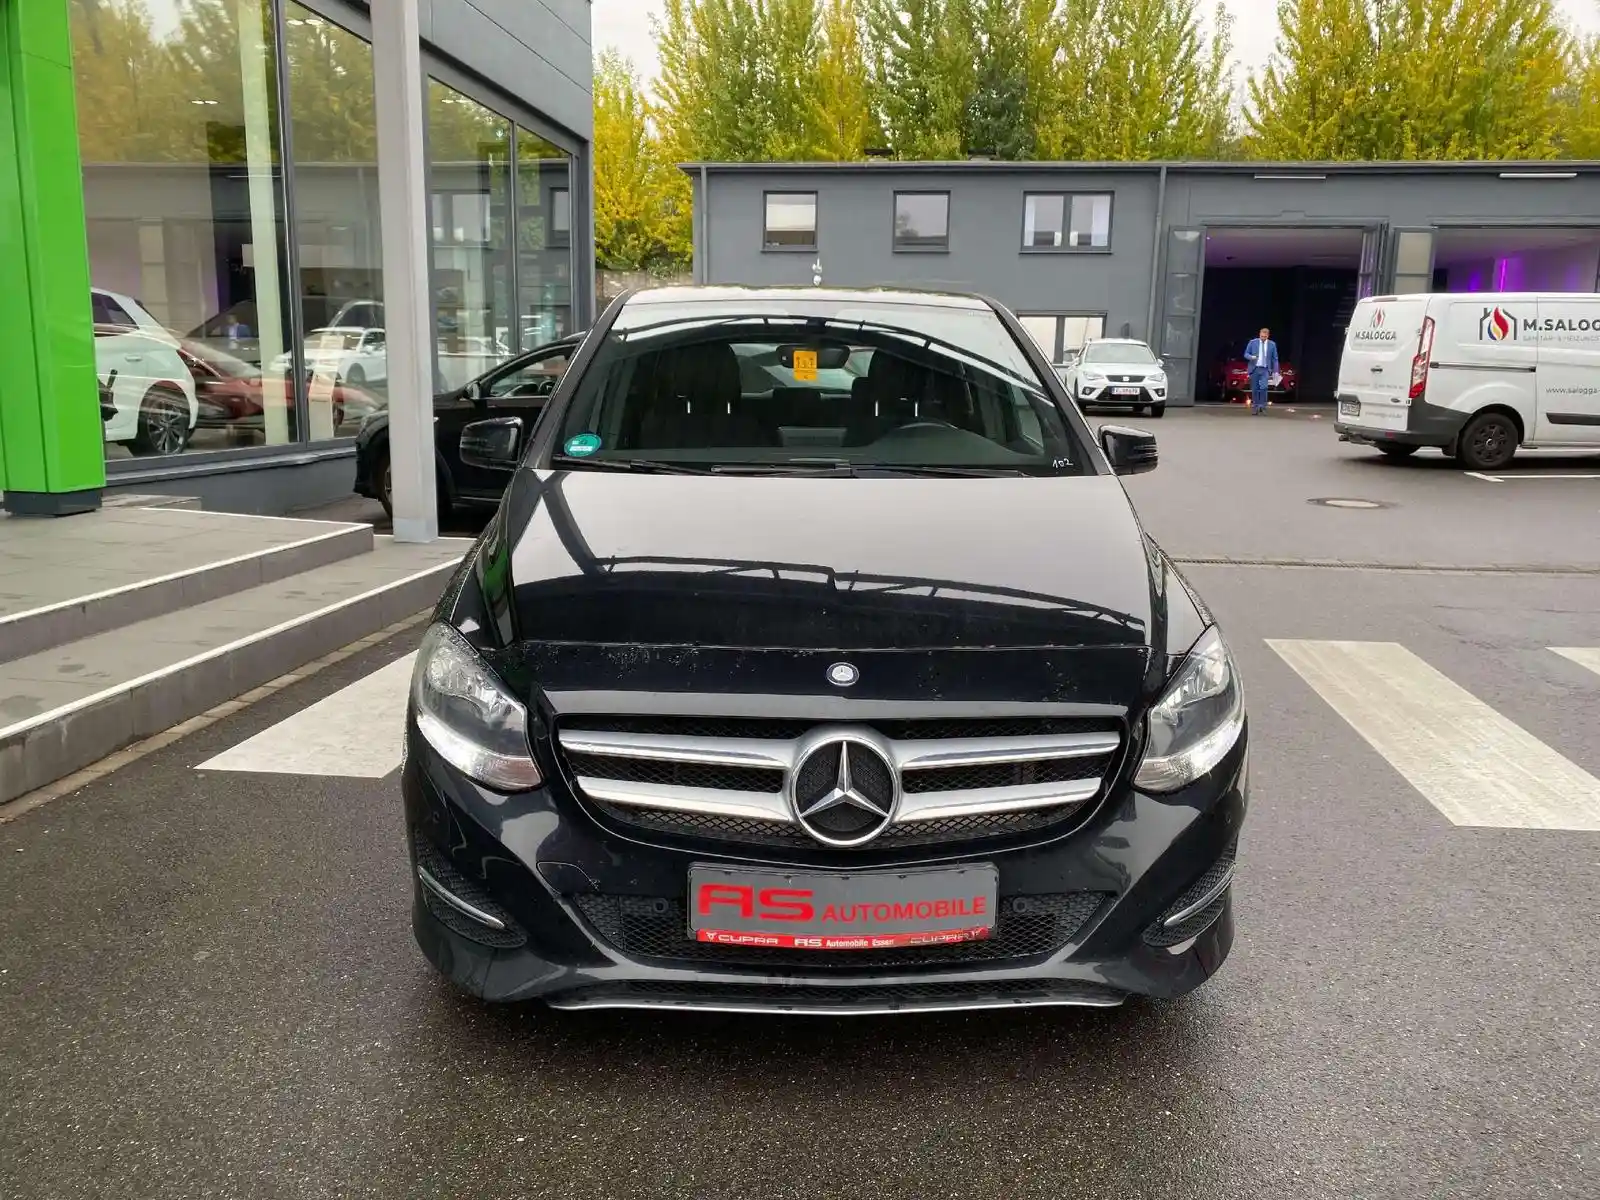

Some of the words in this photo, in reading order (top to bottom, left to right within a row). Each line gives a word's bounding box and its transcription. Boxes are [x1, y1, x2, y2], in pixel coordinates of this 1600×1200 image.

[1052, 458, 1073, 468] 102
[698, 883, 815, 922] AS
[821, 897, 986, 924] AUTOMOBILE
[718, 933, 779, 945] CUPRA
[794, 938, 823, 947] AS
[826, 939, 869, 947] Automobile
